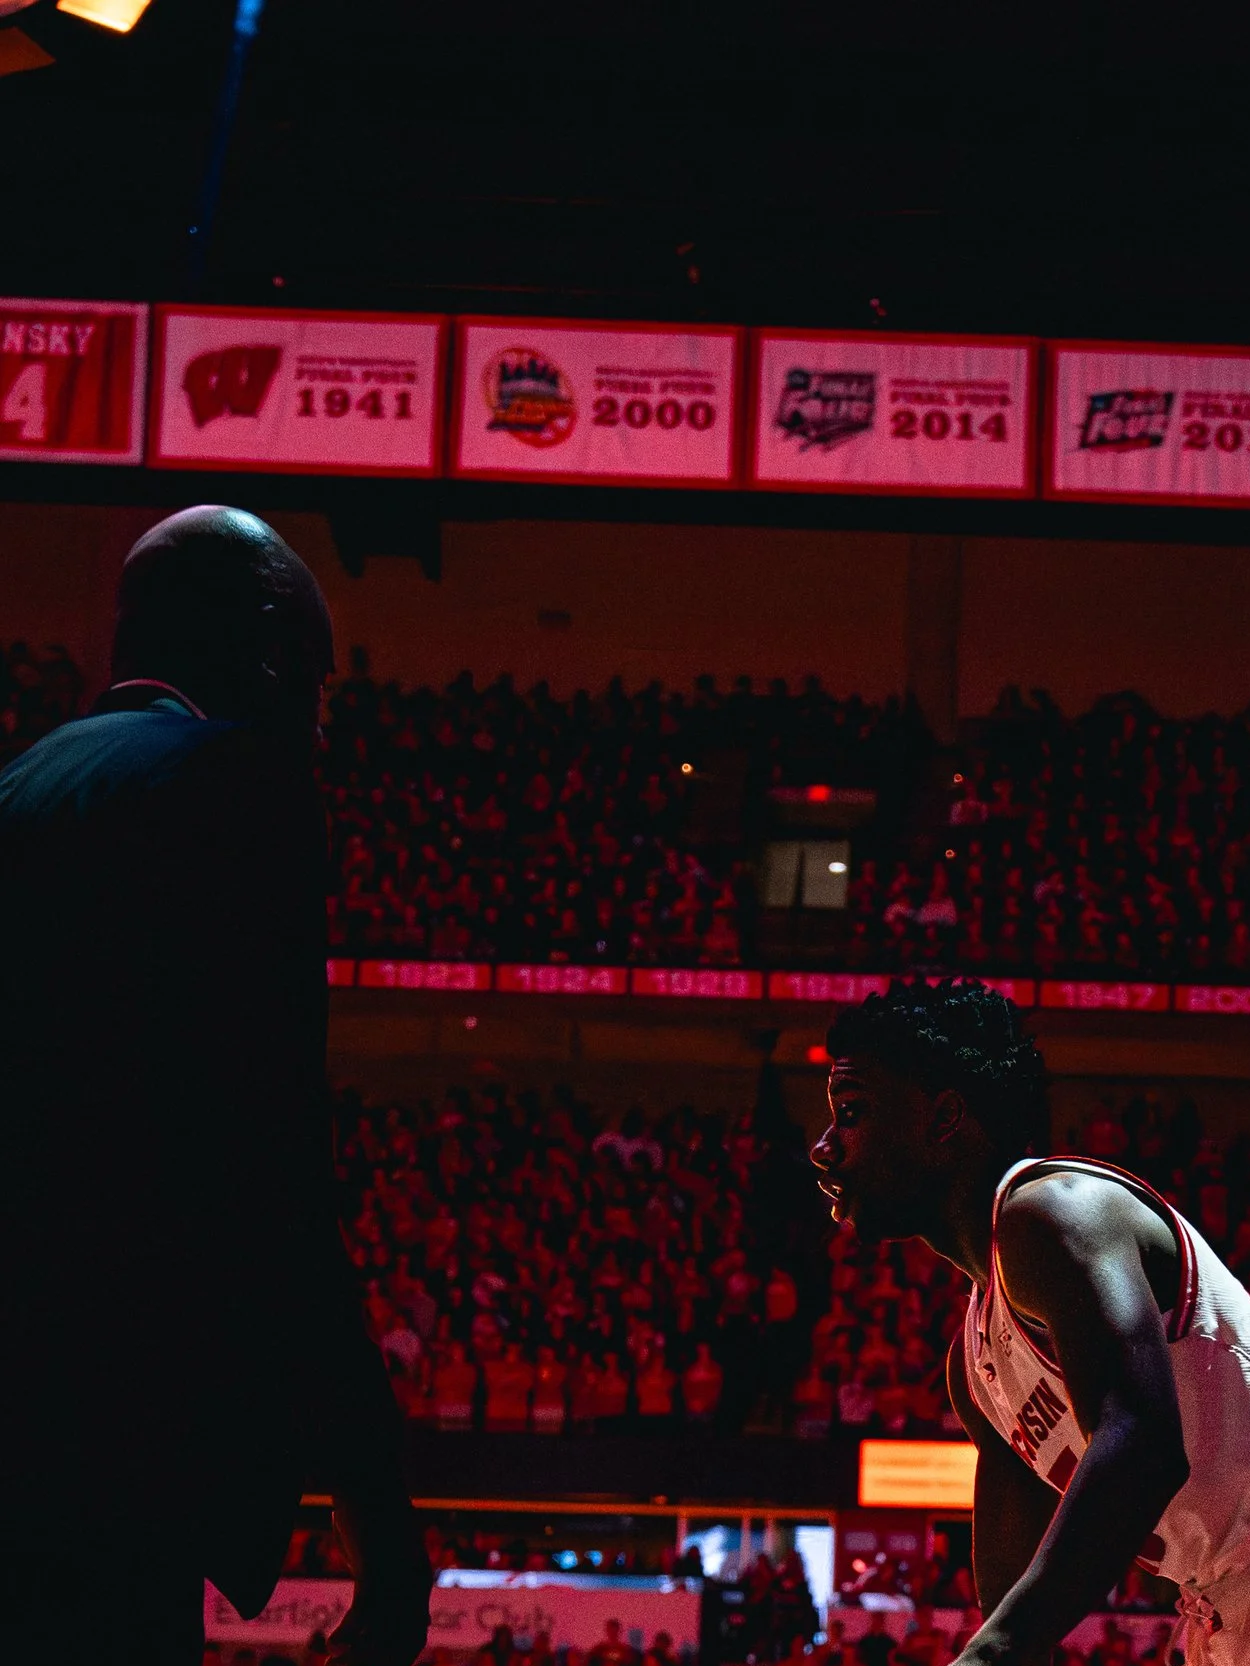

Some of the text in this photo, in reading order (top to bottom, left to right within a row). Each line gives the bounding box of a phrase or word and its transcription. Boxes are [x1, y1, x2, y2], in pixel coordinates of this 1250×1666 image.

[296, 386, 414, 420] 1941
[592, 395, 717, 432] 2000
[890, 409, 1009, 443] 2014
